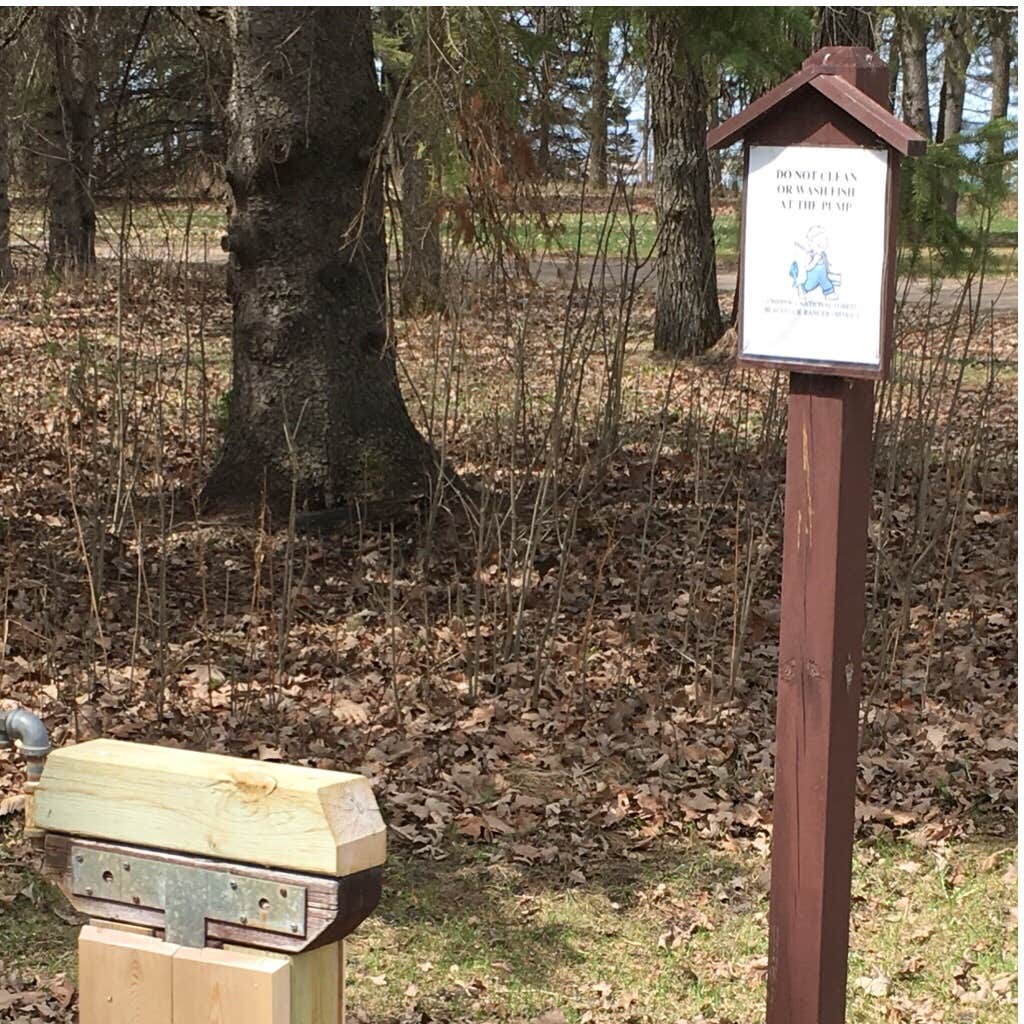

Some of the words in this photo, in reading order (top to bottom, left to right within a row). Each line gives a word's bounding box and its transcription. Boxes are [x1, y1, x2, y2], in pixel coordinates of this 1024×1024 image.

[776, 169, 792, 180] DO
[795, 170, 817, 181] NOT
[820, 171, 857, 182] CLEAN
[777, 184, 792, 195] OR
[796, 185, 828, 196] WASH
[830, 187, 855, 197] FISH
[781, 199, 793, 209] AT
[798, 199, 816, 211] THE
[822, 201, 852, 212] PUMP
